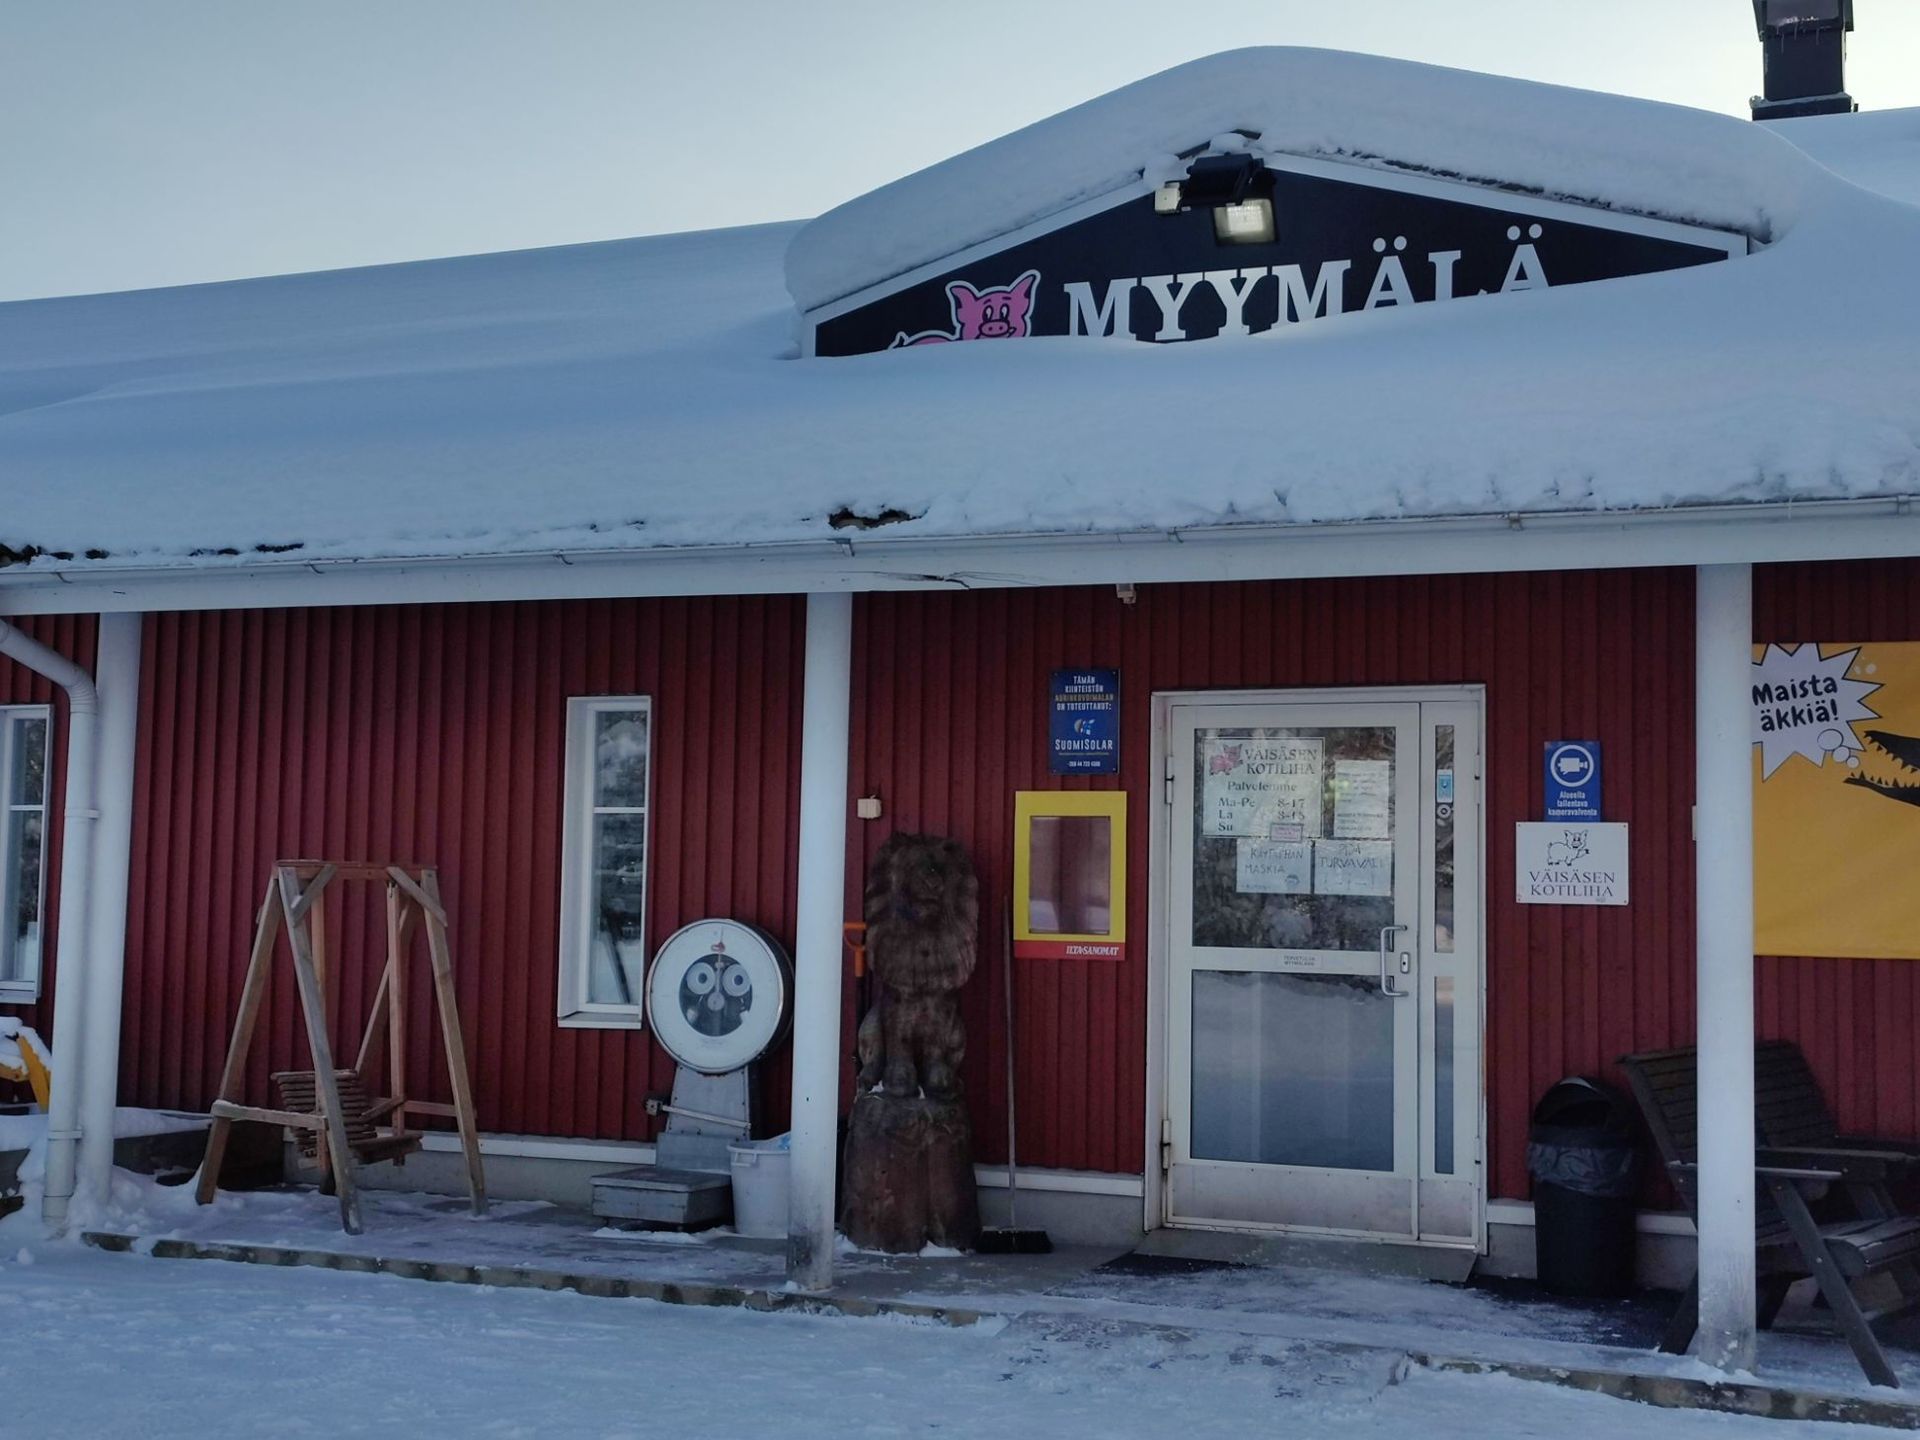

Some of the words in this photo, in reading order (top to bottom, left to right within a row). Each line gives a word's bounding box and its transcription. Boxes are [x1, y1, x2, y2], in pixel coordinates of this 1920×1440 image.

[1064, 223, 1550, 341] MYYMÄLÄ
[1752, 674, 1838, 706] Maista
[1760, 698, 1839, 732] äkkiä!
[1245, 746, 1318, 760] VÄISÄSEN
[1247, 763, 1316, 775] KOTILIHA
[1219, 809, 1234, 820] La
[1218, 821, 1234, 832] Su
[1529, 868, 1615, 884] VÄISÄSEN
[1530, 884, 1614, 897] KOTILIHA
